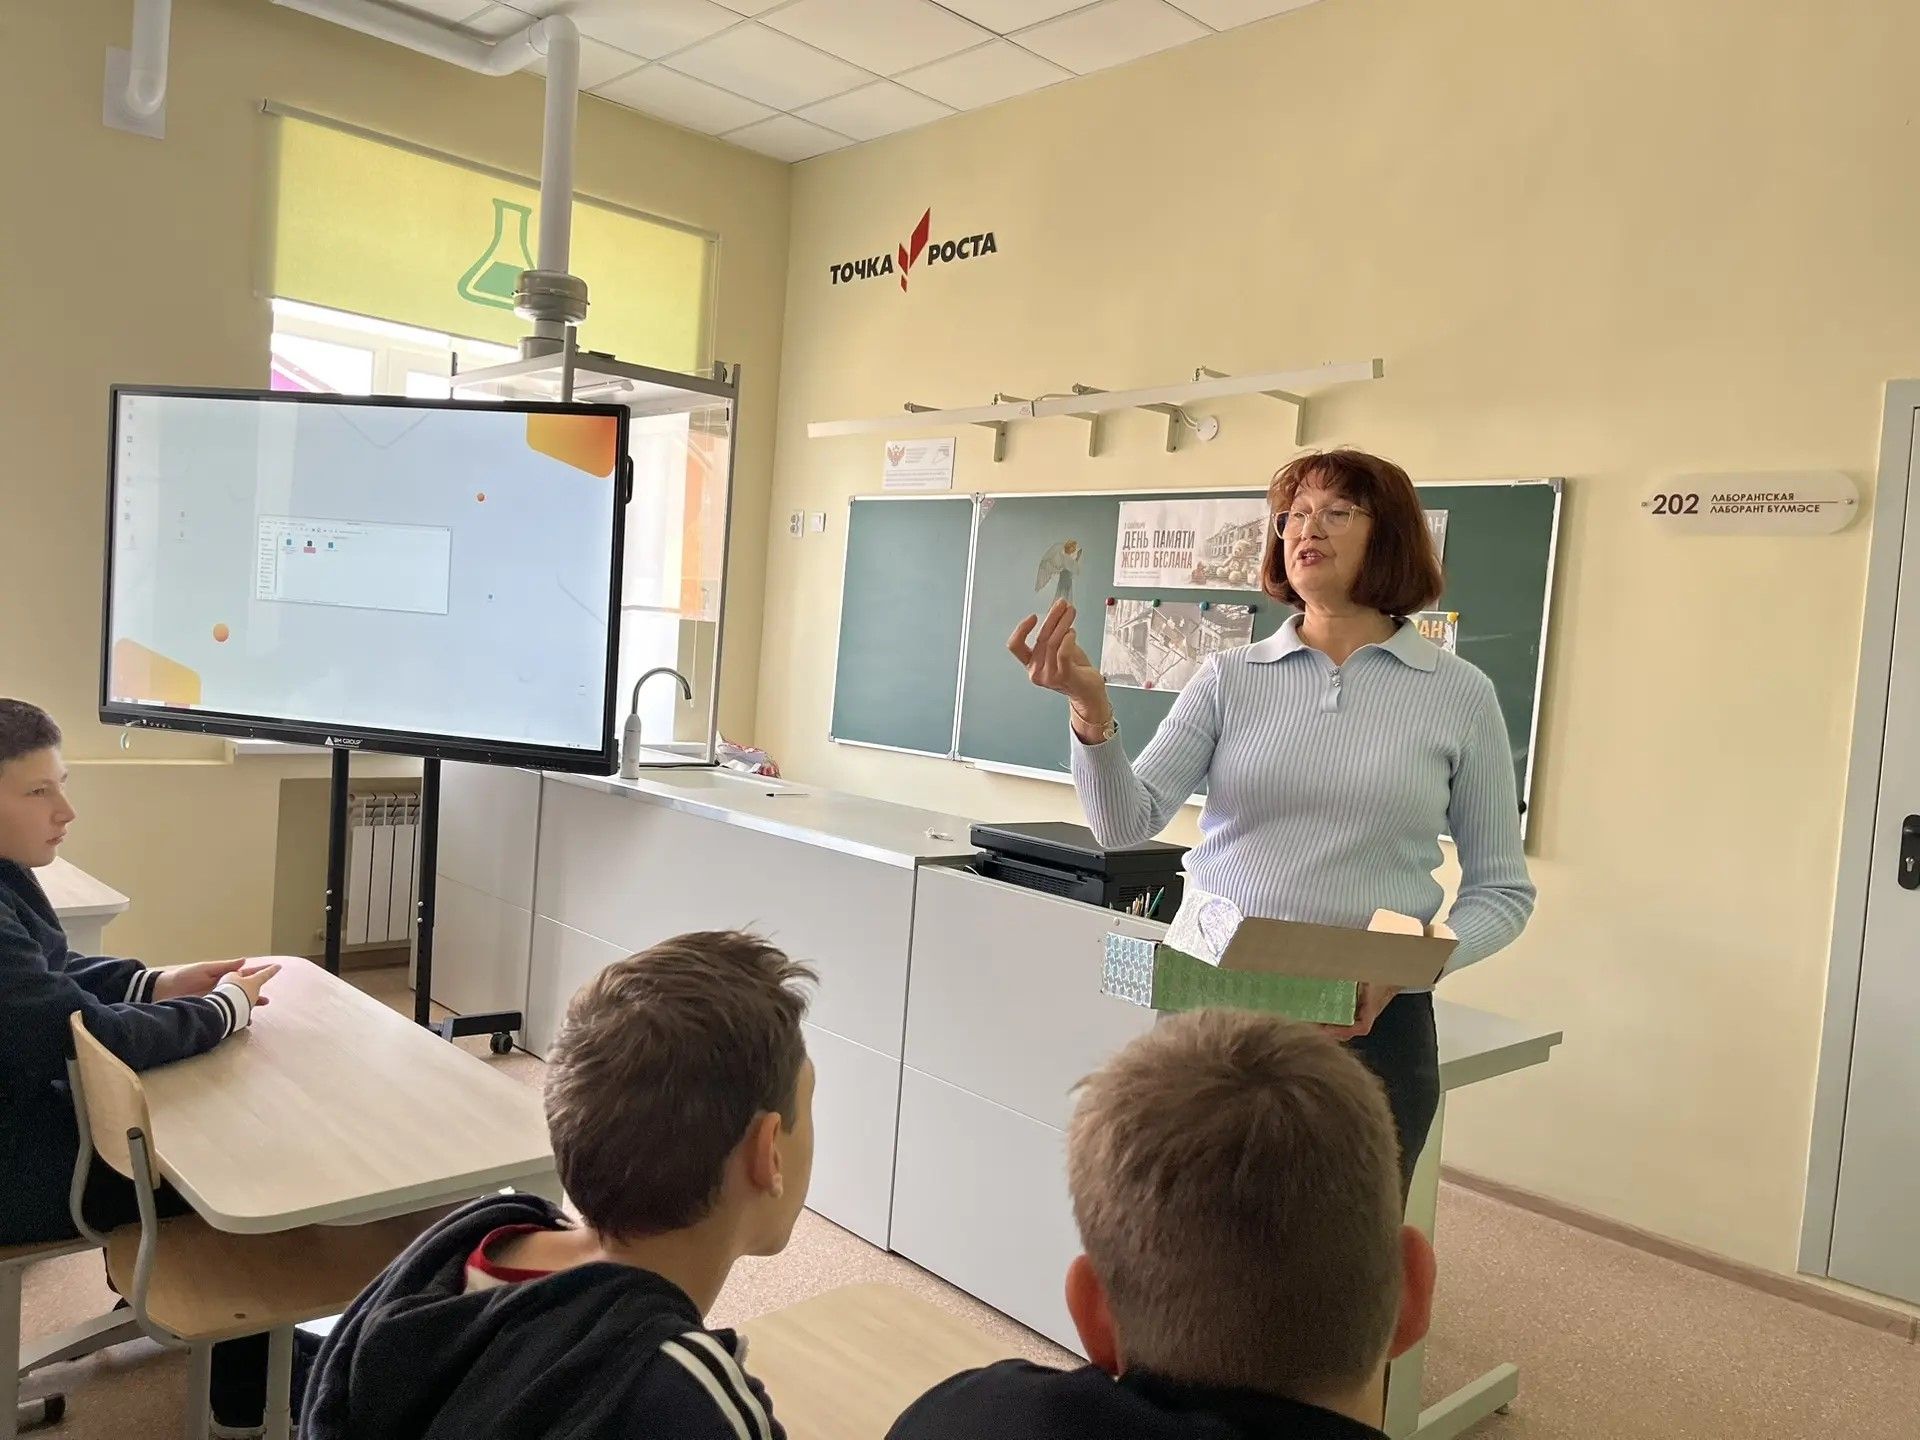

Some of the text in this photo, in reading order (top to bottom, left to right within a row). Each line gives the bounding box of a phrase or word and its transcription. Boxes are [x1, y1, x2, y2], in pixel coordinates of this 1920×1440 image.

[830, 232, 997, 285] ТОЧКА РОСТА
[1652, 493, 1700, 515] 202
[1711, 493, 1794, 502] ЛАБОРАНТСКАЯ
[1710, 504, 1820, 514] ЛАБОРАНТ БҮЛМӘСЕ
[1122, 530, 1195, 550] ДЕНЬ ПАМЯТИ
[1121, 551, 1193, 569] ЖЕРТВ БЕСЛАНА
[1417, 619, 1444, 639] АН
